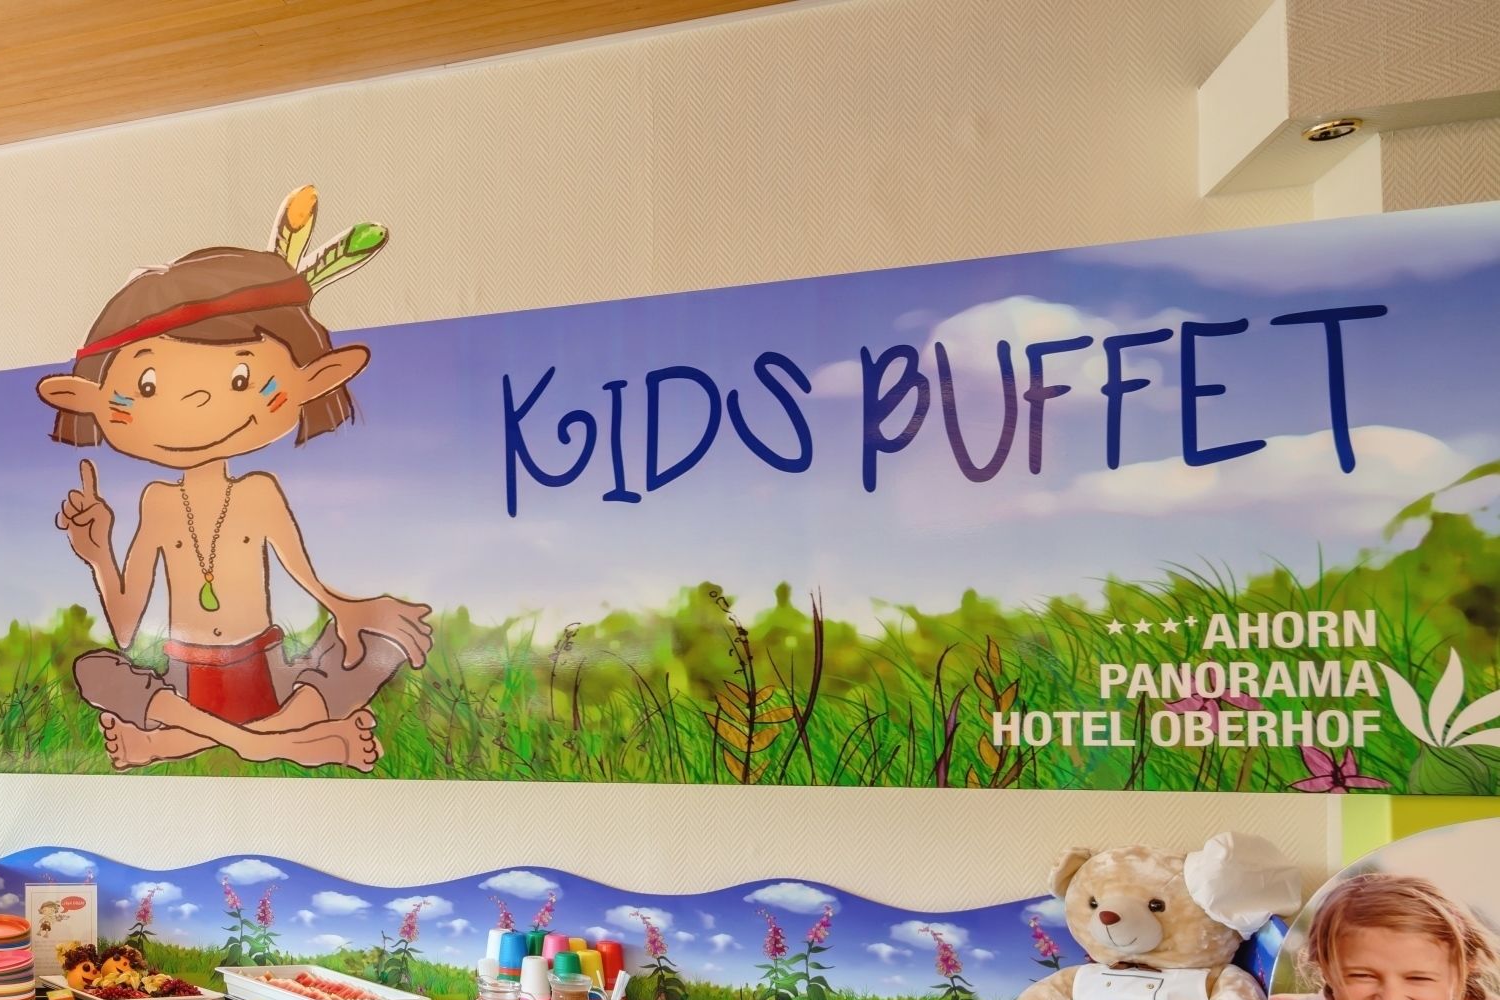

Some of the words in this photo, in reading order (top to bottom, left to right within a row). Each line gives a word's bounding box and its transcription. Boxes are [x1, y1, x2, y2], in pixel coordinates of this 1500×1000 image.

[501, 351, 814, 519] KIDS
[860, 304, 1389, 494] BUFFET
[1202, 609, 1377, 650] AHORN
[1100, 659, 1381, 699] PANORAMA
[992, 710, 1136, 747] HOTEL
[1150, 709, 1381, 749] OBERHOF
